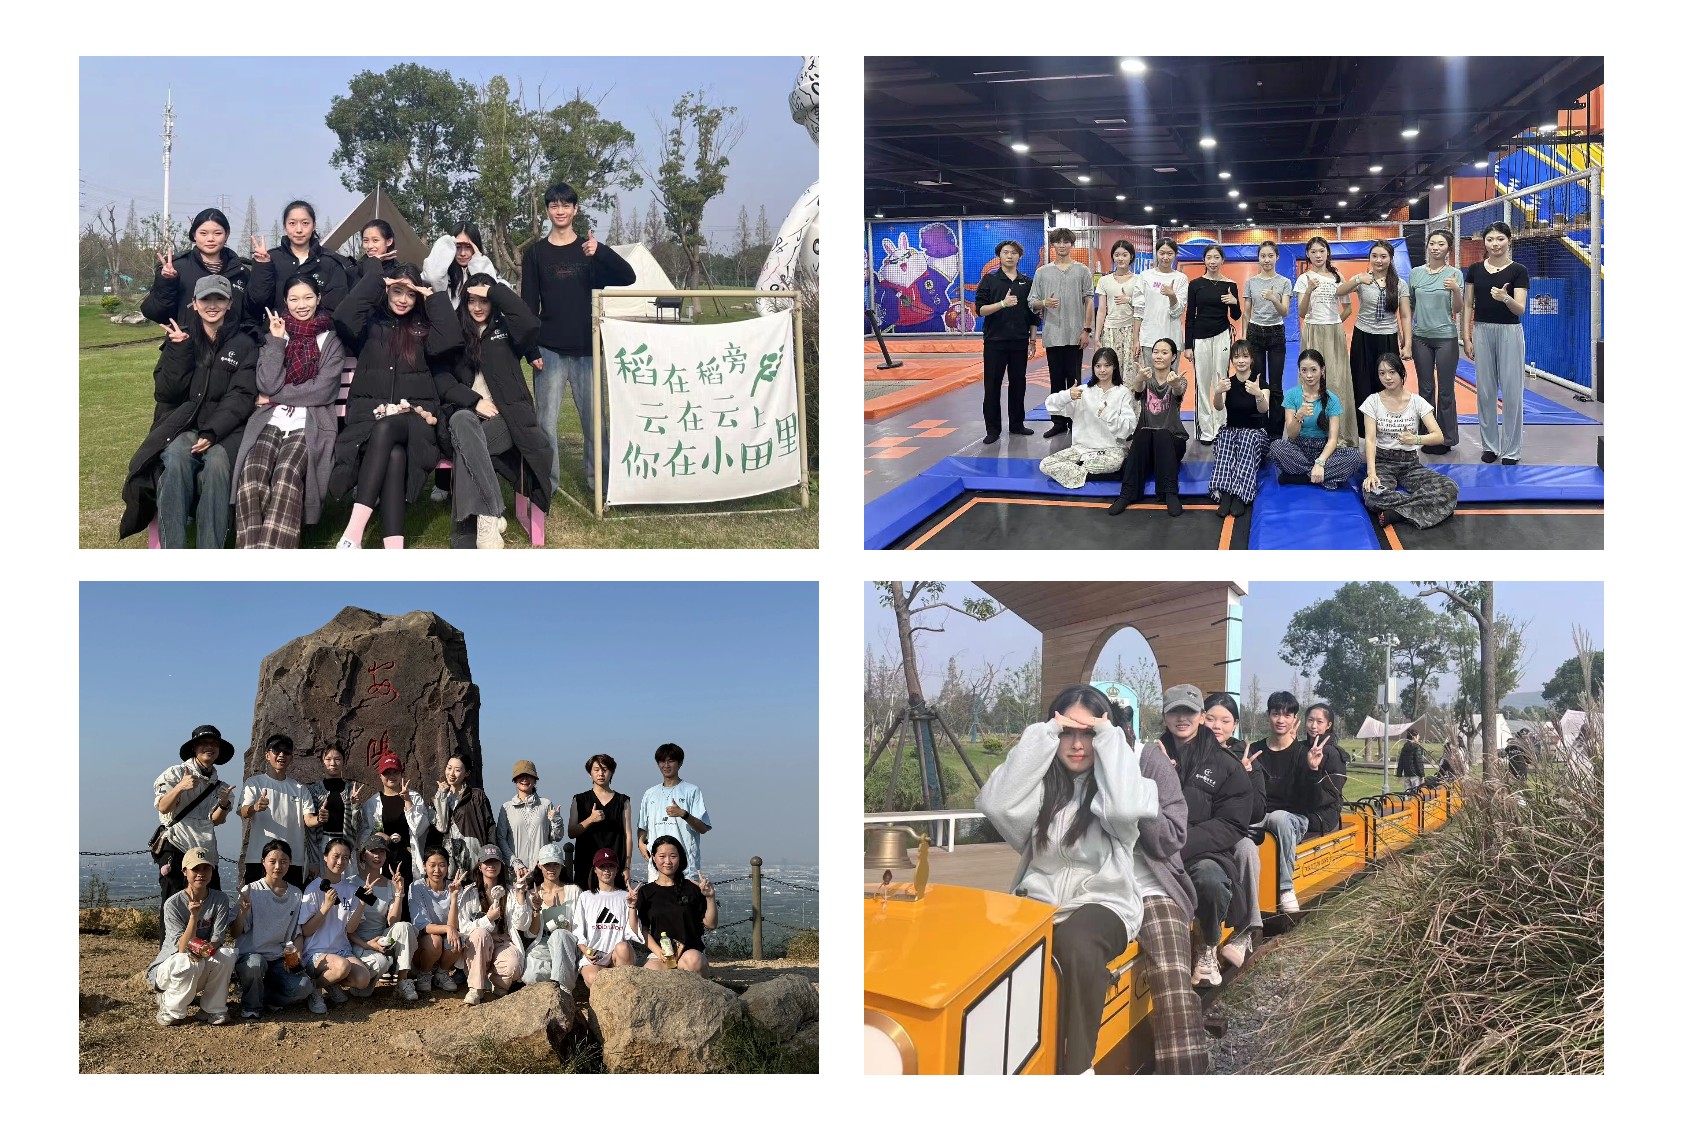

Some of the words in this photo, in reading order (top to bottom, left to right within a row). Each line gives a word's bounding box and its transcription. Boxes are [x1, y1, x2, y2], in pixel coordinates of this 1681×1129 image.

[613, 341, 747, 395] 稻在稻旁
[635, 394, 767, 435] 云在云上
[621, 412, 798, 480] 你在小田里
[343, 897, 351, 910] LA
